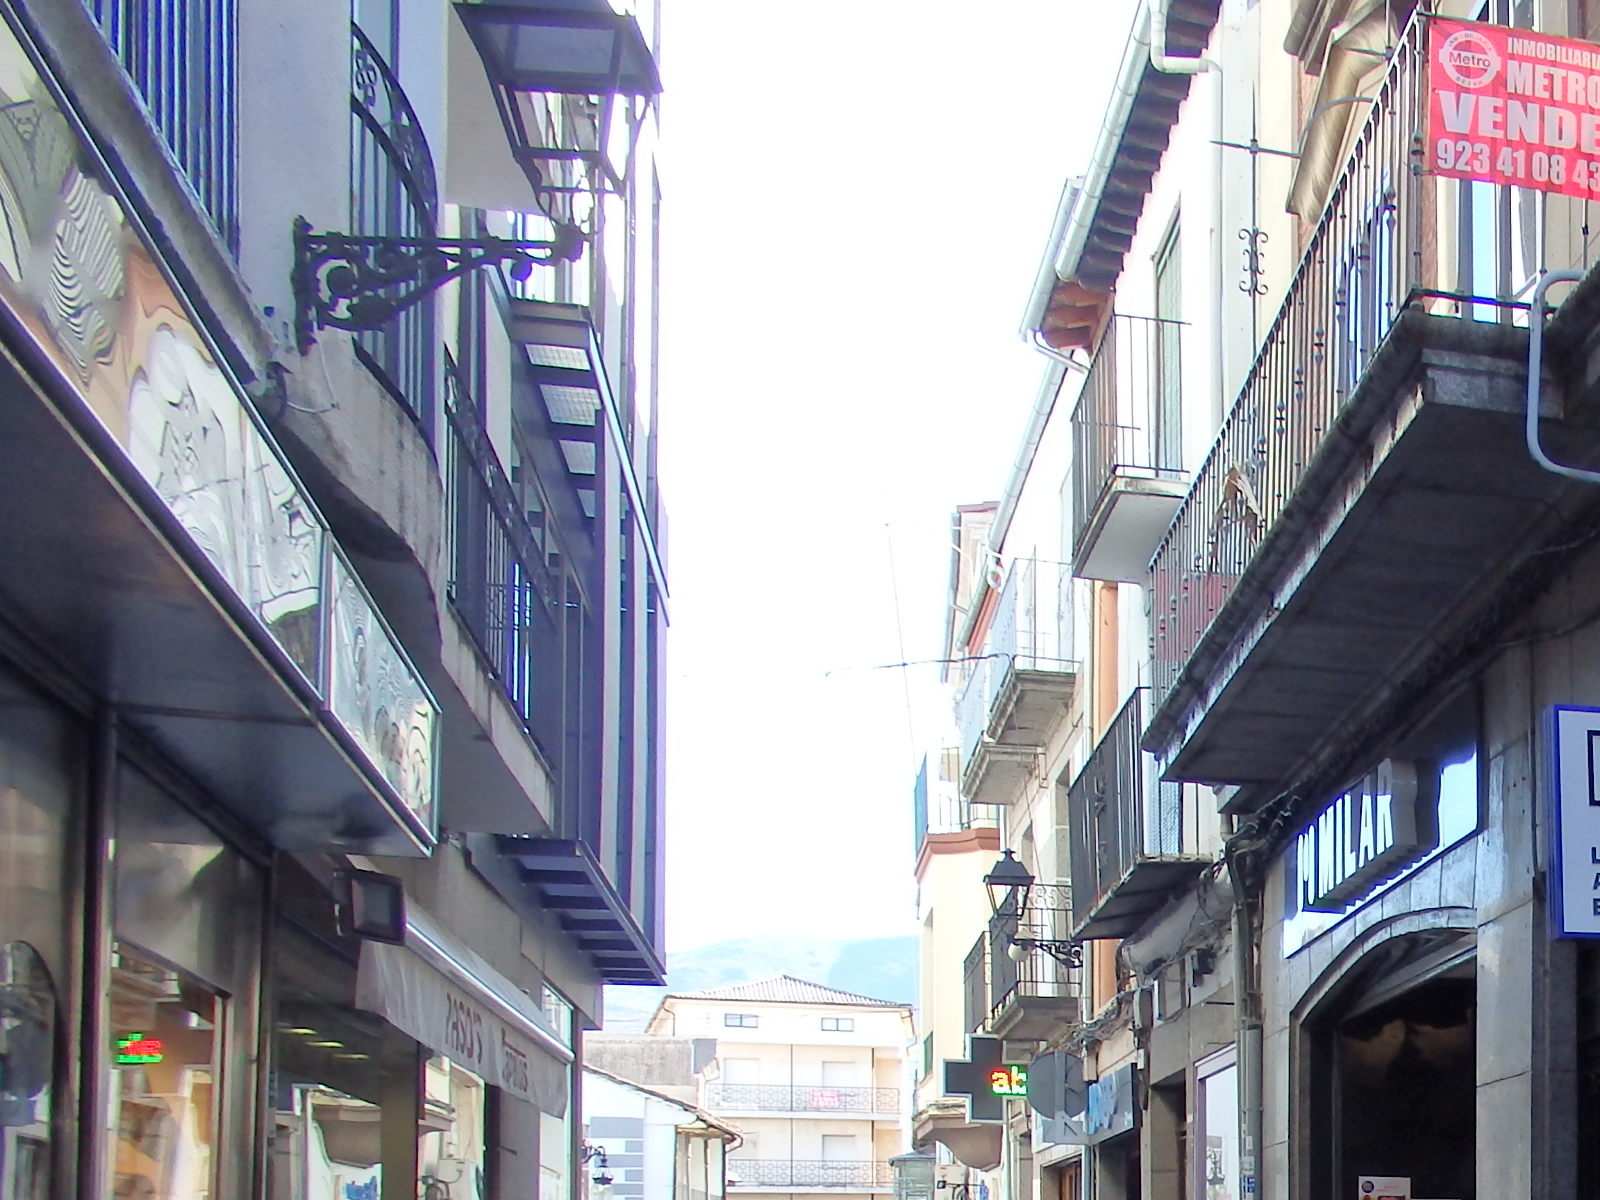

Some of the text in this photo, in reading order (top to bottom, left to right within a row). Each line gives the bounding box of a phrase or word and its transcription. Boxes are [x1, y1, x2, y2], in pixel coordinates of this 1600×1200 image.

[1449, 52, 1491, 67] Metro
[1437, 138, 1490, 175] 923
[1497, 147, 1525, 178] 41
[1531, 152, 1566, 184] 08
